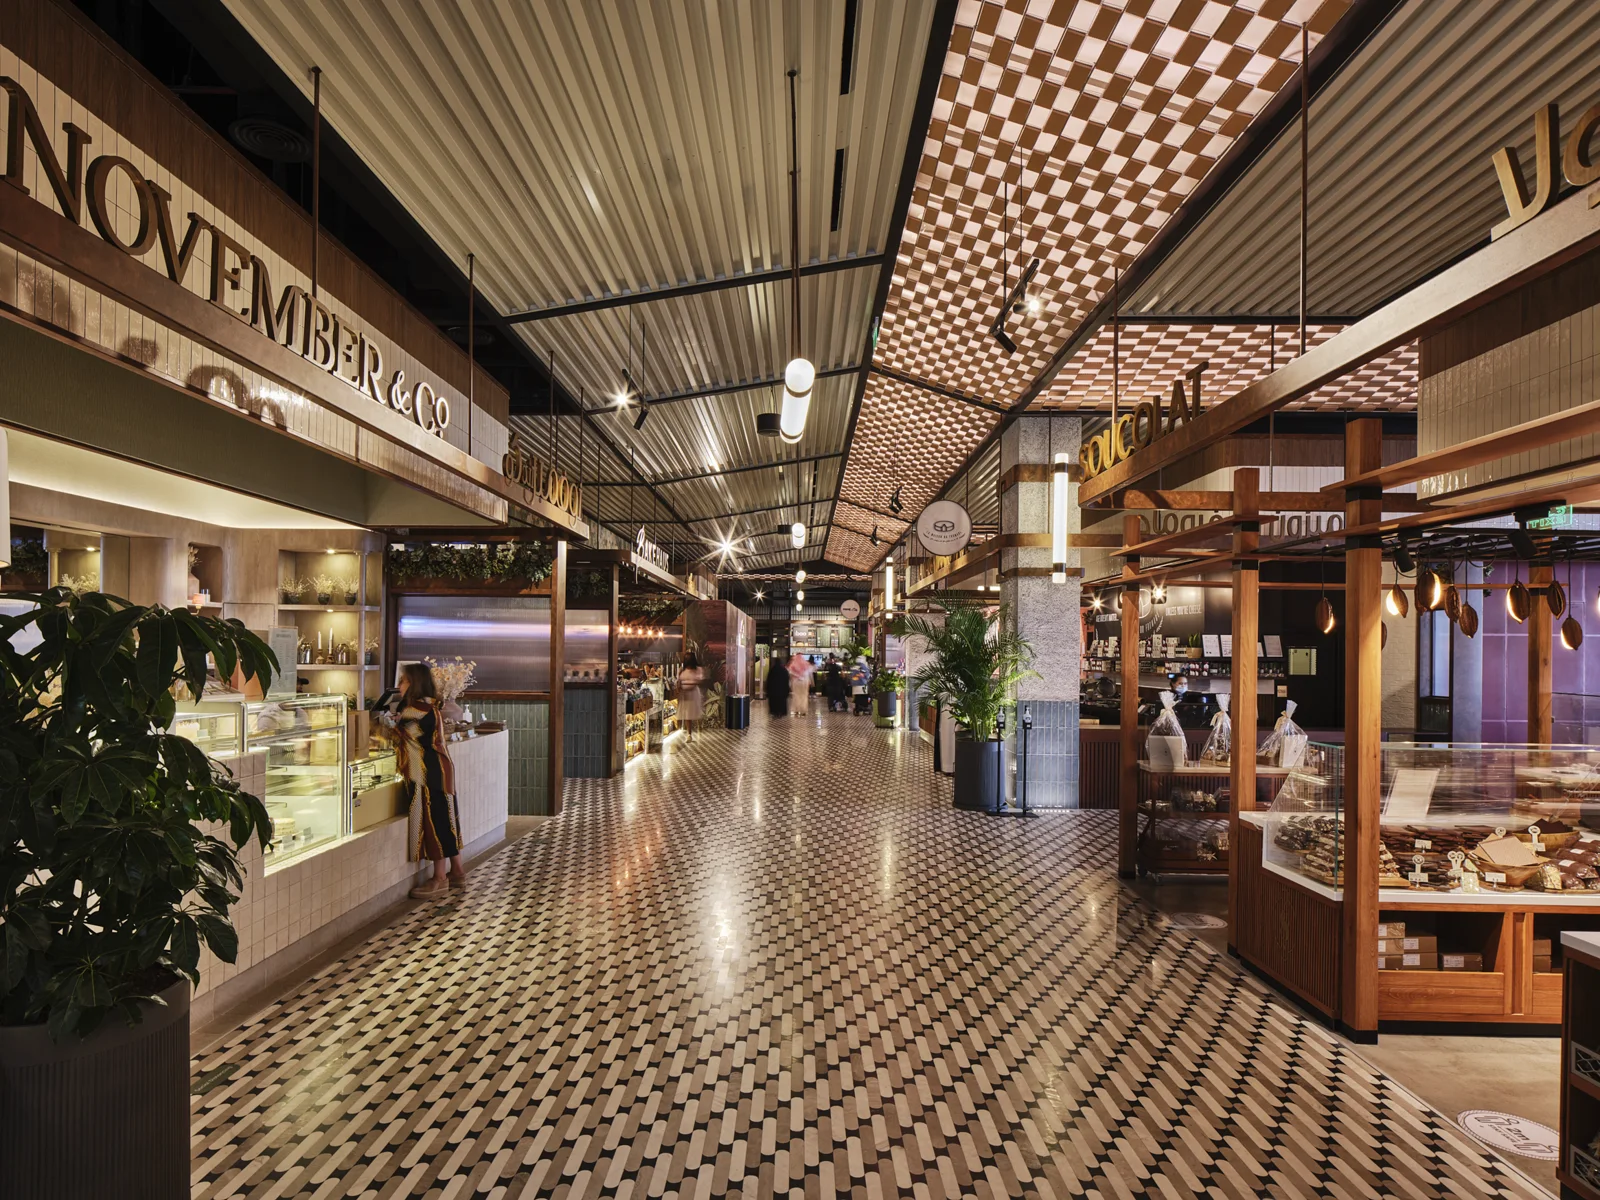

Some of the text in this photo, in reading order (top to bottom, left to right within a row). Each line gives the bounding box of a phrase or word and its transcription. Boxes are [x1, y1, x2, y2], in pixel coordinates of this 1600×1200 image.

[0, 76, 386, 405] NOVEMBER
[388, 370, 412, 415] &
[1079, 361, 1209, 484] SOUCOLAT
[1506, 1127, 1530, 1141] 2m
